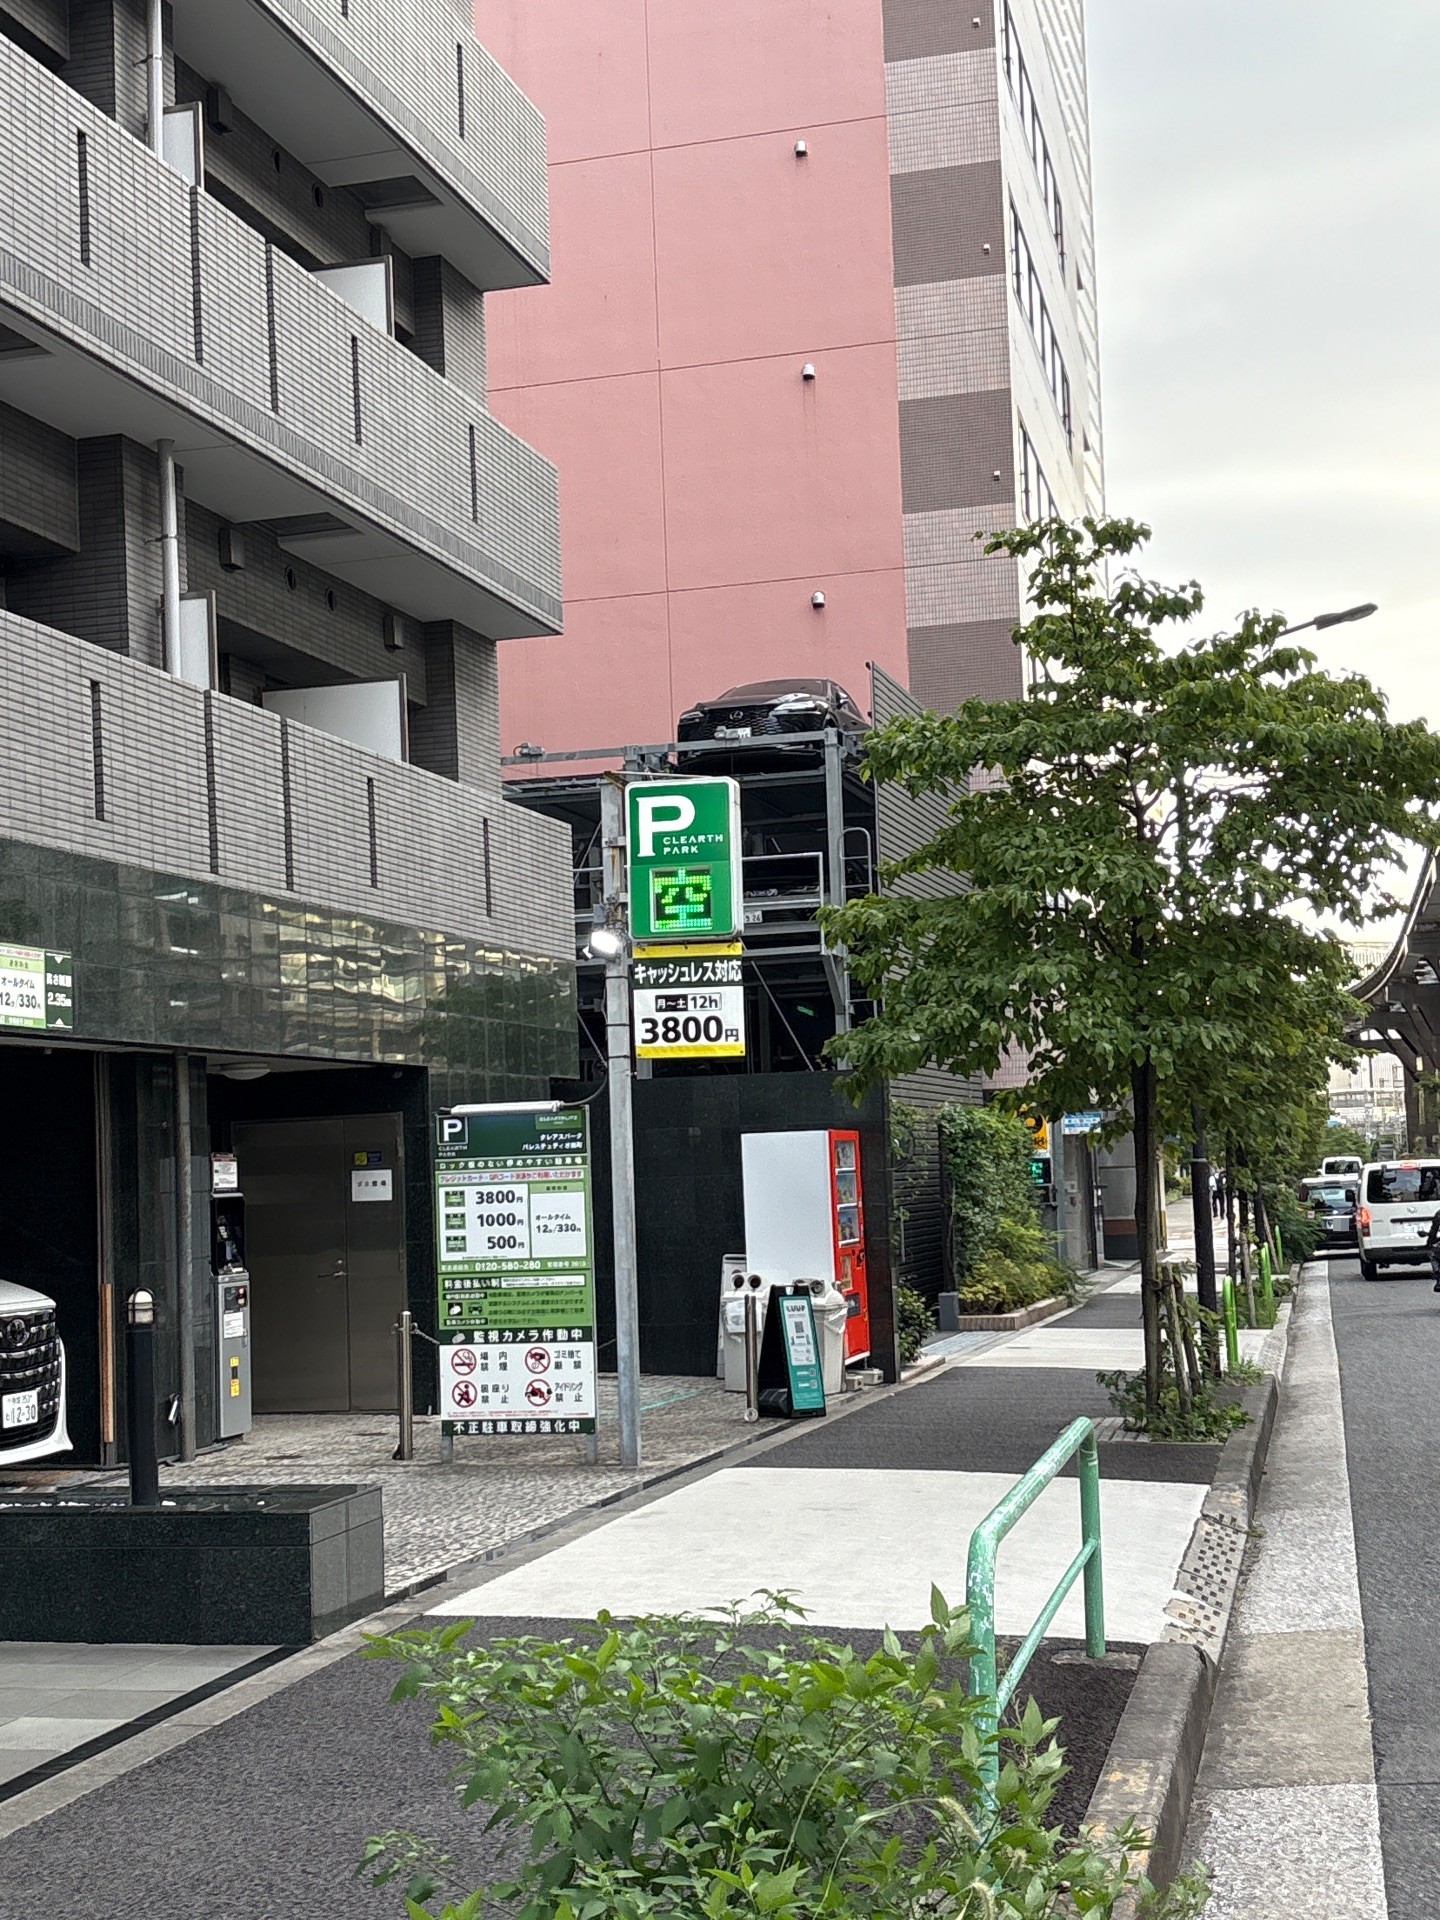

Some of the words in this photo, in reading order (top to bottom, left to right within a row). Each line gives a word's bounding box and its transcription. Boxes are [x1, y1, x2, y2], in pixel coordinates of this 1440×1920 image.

[636, 795, 696, 857] P
[663, 834, 724, 845] CLEARTH
[663, 845, 699, 856] PARK
[653, 867, 713, 930] 空
[634, 959, 743, 985] キャッシュレス対応
[1, 976, 36, 989] オールタイム
[690, 995, 719, 1010] 12h
[641, 1015, 740, 1044] 3800円
[443, 1118, 463, 1142] P
[475, 1190, 524, 1205] 3800円
[476, 1212, 524, 1227] 1000円
[535, 1213, 572, 1221] オールタイム
[487, 1235, 525, 1250] 500円
[475, 1260, 542, 1271] 0120-580-280
[473, 1328, 583, 1344] 監視カメラ作動中
[554, 1381, 583, 1392] アイドリング
[453, 1420, 581, 1434] 不正駐車取締強化中
